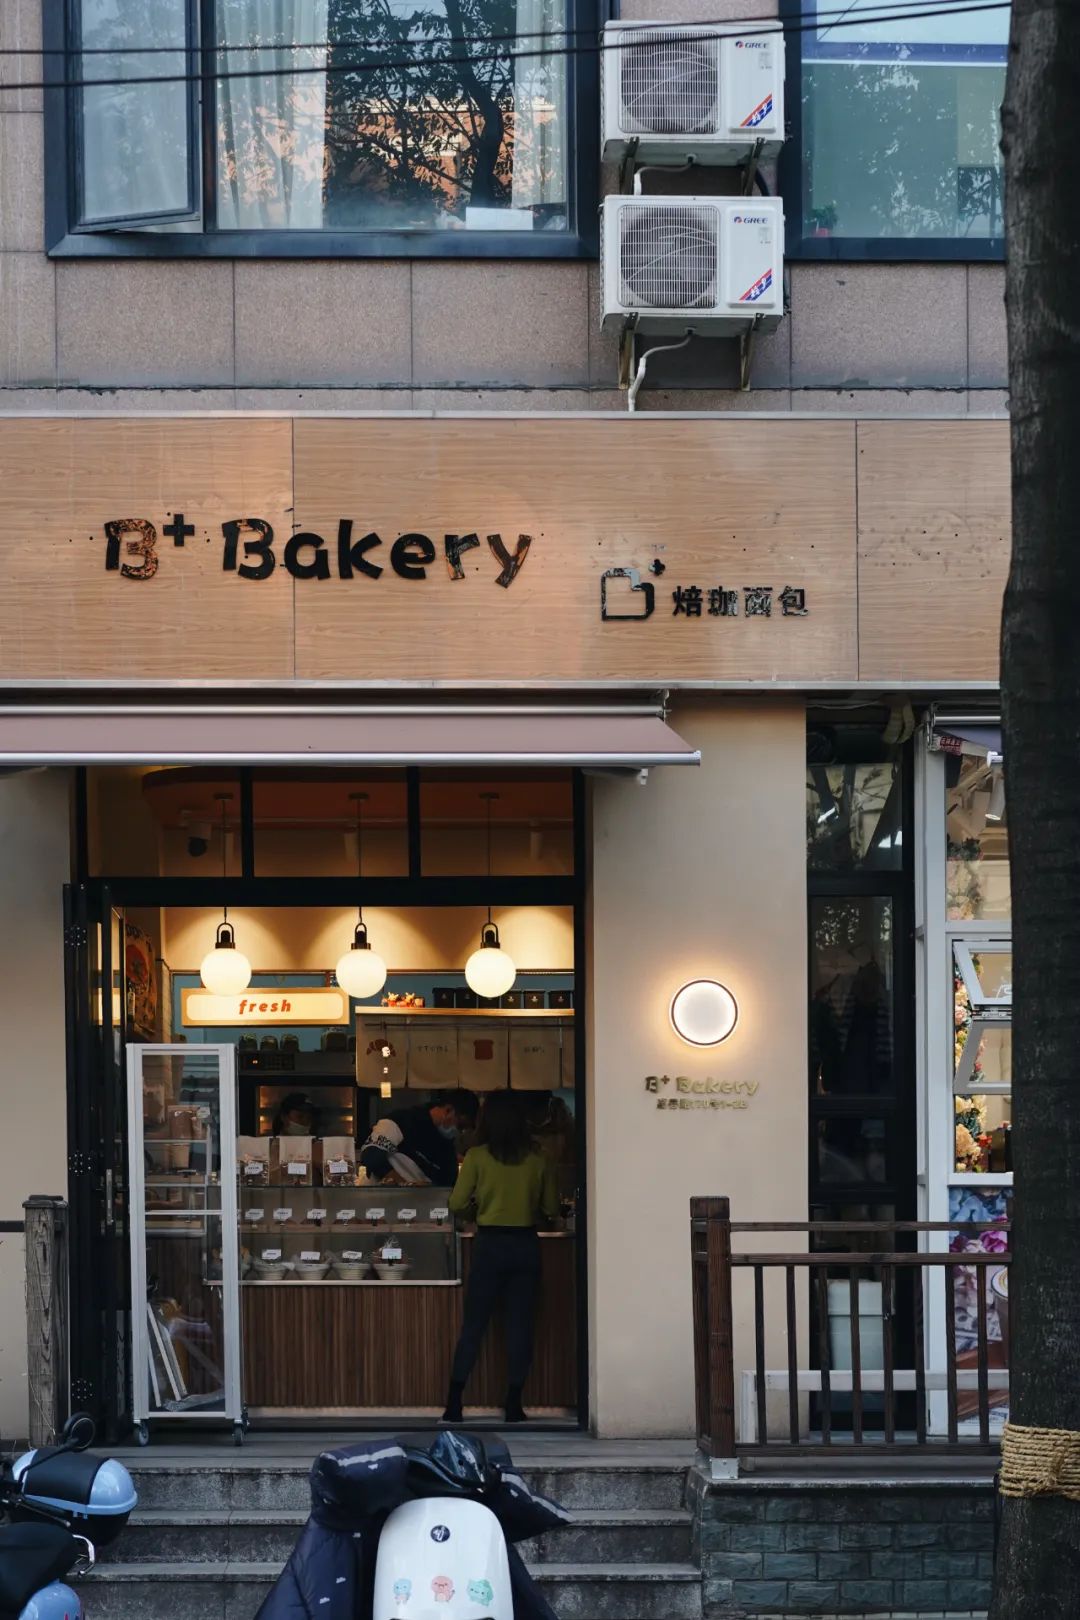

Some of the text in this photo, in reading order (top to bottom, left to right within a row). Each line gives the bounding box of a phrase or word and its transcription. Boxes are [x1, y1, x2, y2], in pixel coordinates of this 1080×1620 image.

[743, 216, 768, 224] GREE
[222, 518, 532, 589] Bakery
[239, 999, 291, 1015] fresh
[675, 1076, 760, 1096] Bakery
